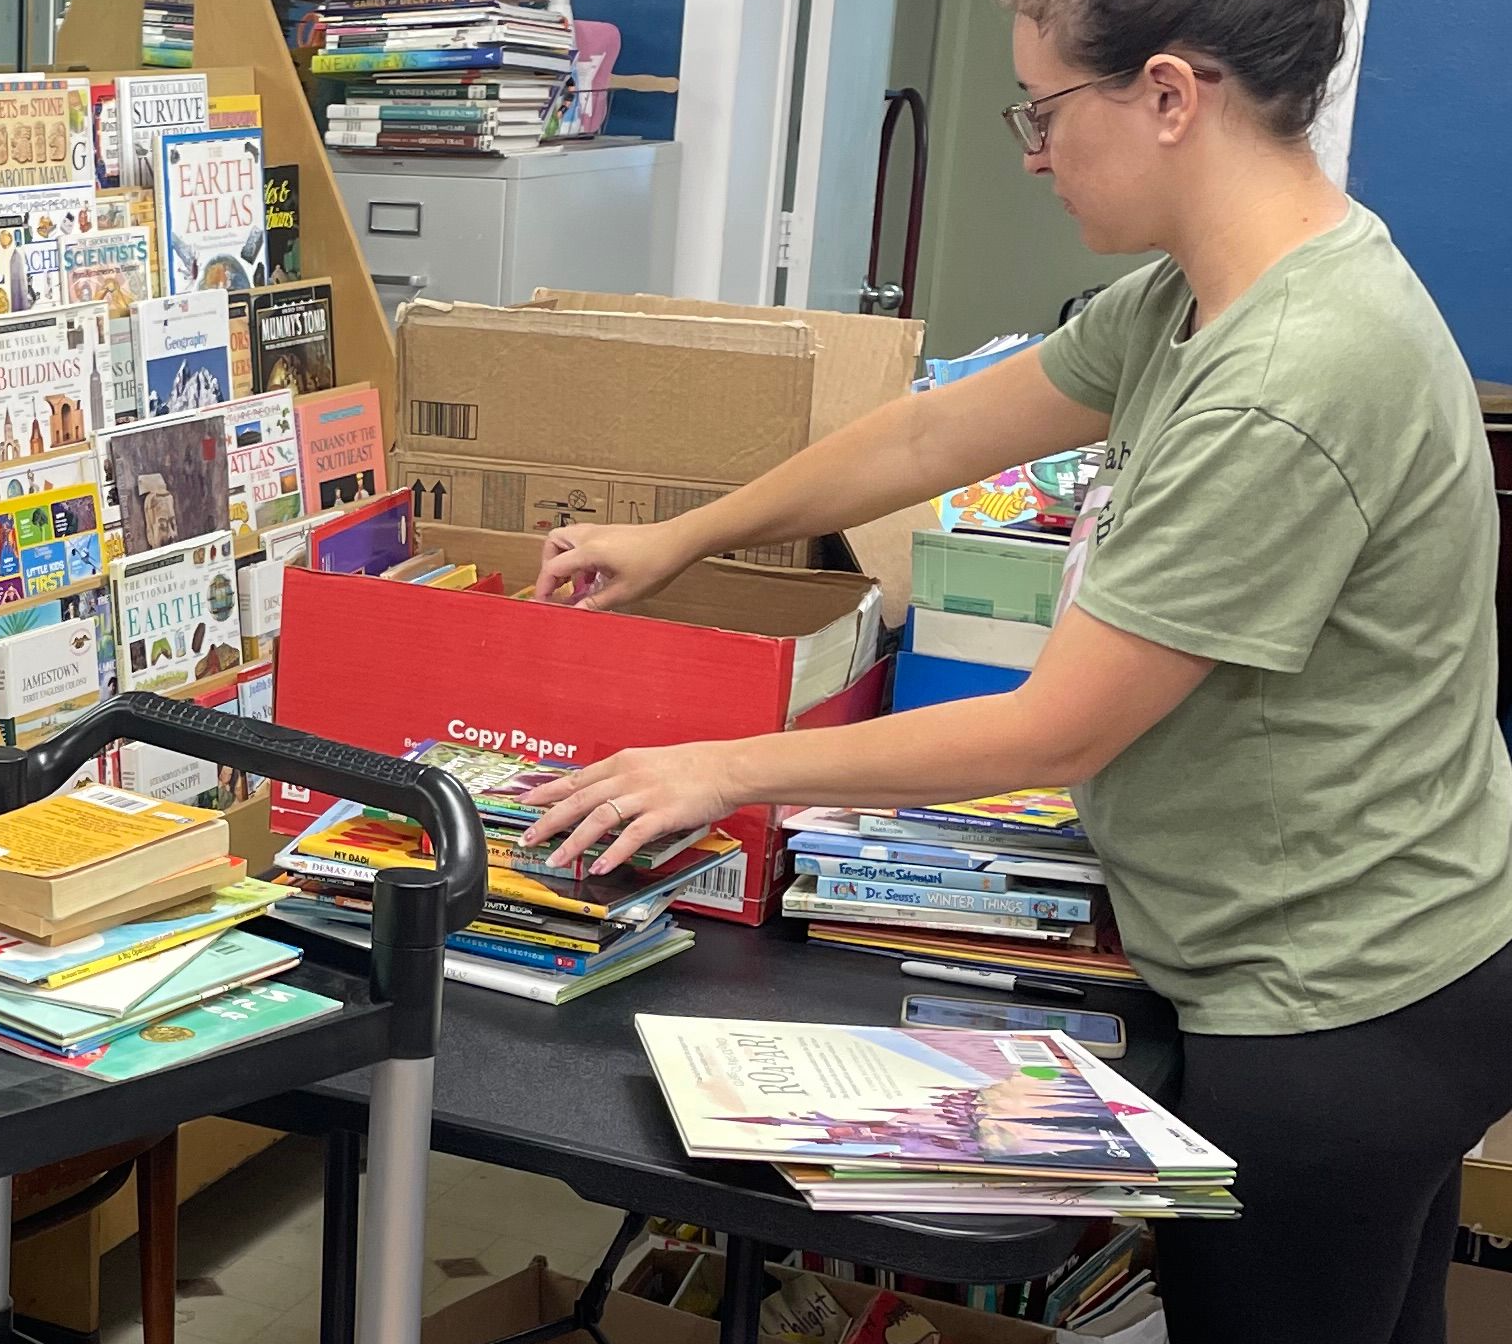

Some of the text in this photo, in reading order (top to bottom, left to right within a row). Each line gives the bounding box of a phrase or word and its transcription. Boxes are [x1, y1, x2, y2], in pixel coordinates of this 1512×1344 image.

[319, 57, 357, 71] NEW
[31, 97, 64, 118] STONE
[133, 97, 204, 125] SURVIVE
[179, 158, 254, 197] EARTH
[186, 194, 253, 234] ATLAS
[64, 241, 147, 271] SCIENTISTS
[303, 308, 326, 333] TOMB
[165, 331, 208, 352] Geography
[310, 427, 377, 455] INDIANS OF THE
[230, 447, 276, 474] ATLAS
[316, 445, 373, 473] SOUTHEAST
[253, 482, 278, 503] RLD
[1057, 471, 1076, 496] THE
[27, 570, 65, 596] FIRST
[125, 571, 174, 592] THE VISUAL
[125, 584, 178, 605] DICTIONARY
[126, 592, 203, 638] EARTH
[23, 662, 80, 692] JAMESTOWN
[448, 719, 578, 759] Copy Paper
[334, 850, 347, 861] MY
[879, 867, 894, 878] the
[484, 902, 533, 915] TIVITY BOOK
[864, 886, 1023, 914] Dr. Seuss's WINTER THINGS
